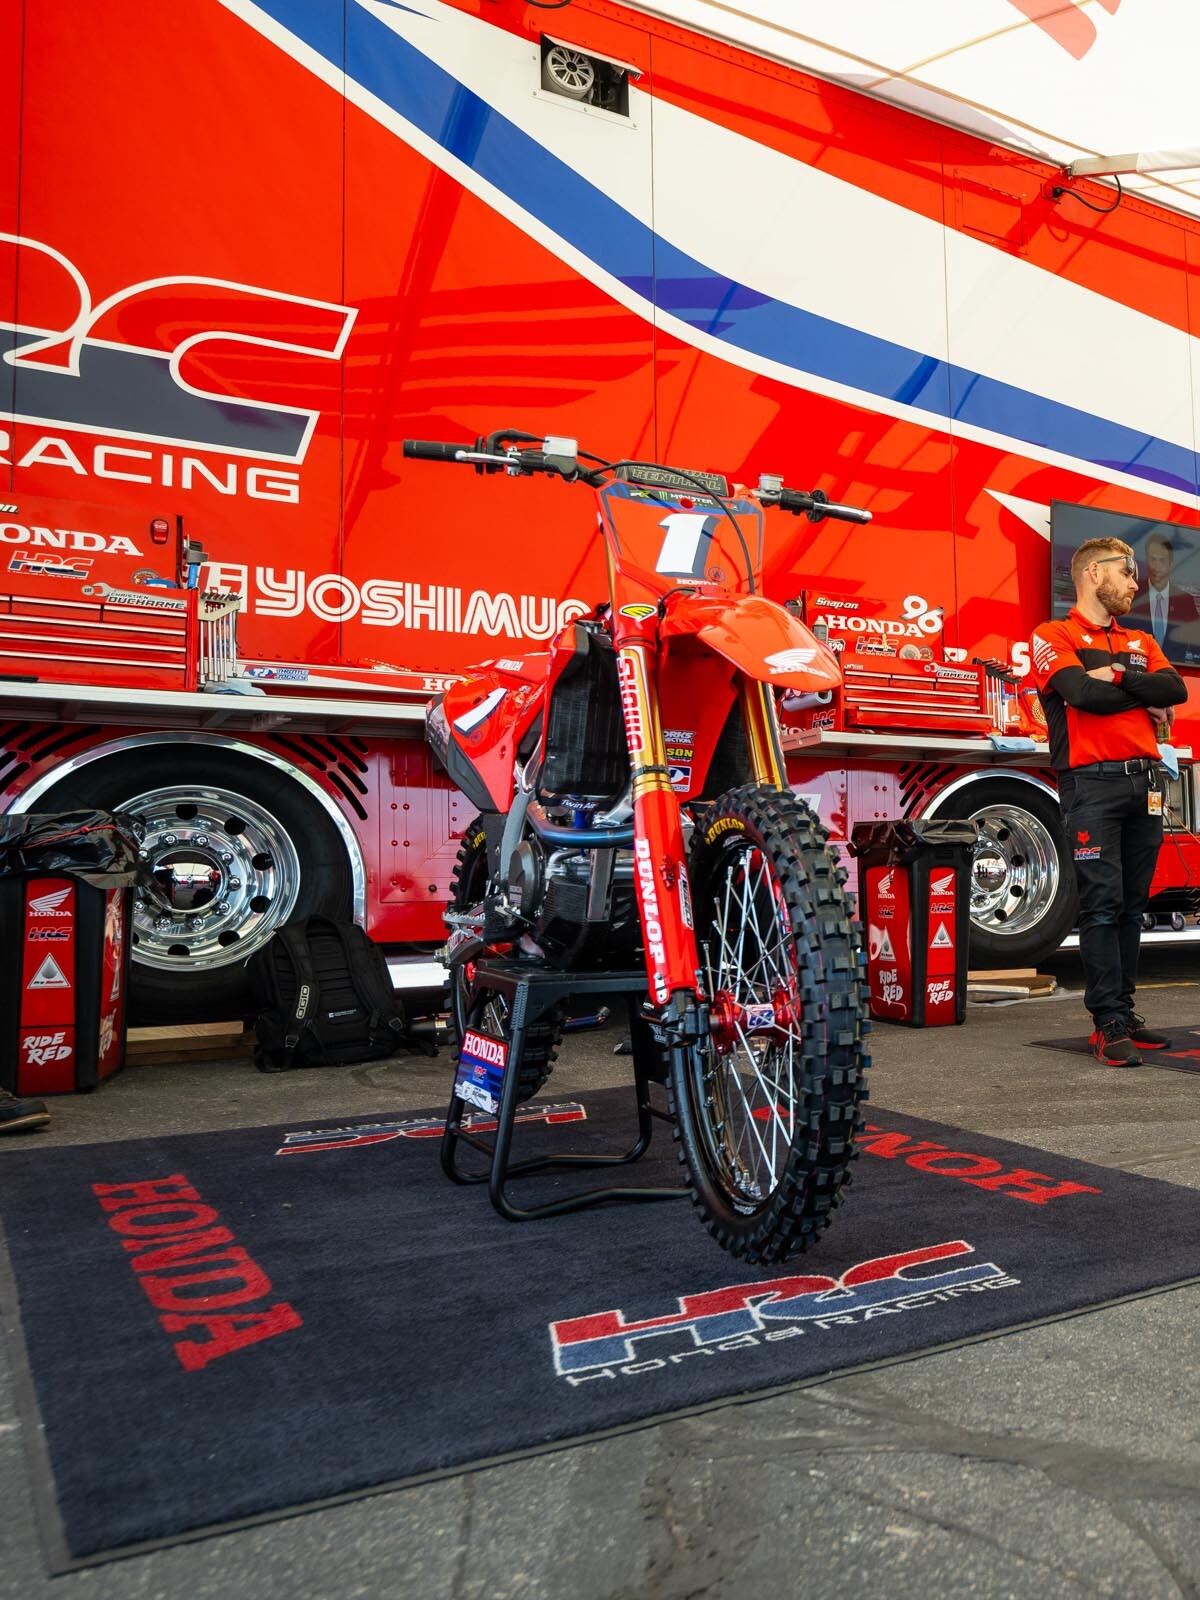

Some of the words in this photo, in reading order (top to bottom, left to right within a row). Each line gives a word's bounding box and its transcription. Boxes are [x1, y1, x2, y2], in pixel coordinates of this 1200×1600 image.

[0, 523, 144, 557] ONDA
[655, 513, 714, 577] 1
[107, 597, 187, 610] DUCHARME
[256, 566, 592, 640] YOSHIMU
[815, 597, 859, 610] Snap-on
[901, 595, 945, 634] 96
[826, 614, 925, 638] HONDA
[29, 910, 73, 918] HONDA
[635, 838, 667, 966] DUNLOP
[296, 984, 310, 1019] OGIO
[928, 990, 954, 1006] RED
[22, 1031, 67, 1050] RIDE
[26, 1046, 73, 1067] RED
[462, 1032, 505, 1067] HONDA
[92, 1174, 304, 1371] HONDA
[548, 1239, 1005, 1376] HRC
[816, 1275, 1022, 1330] RACING
